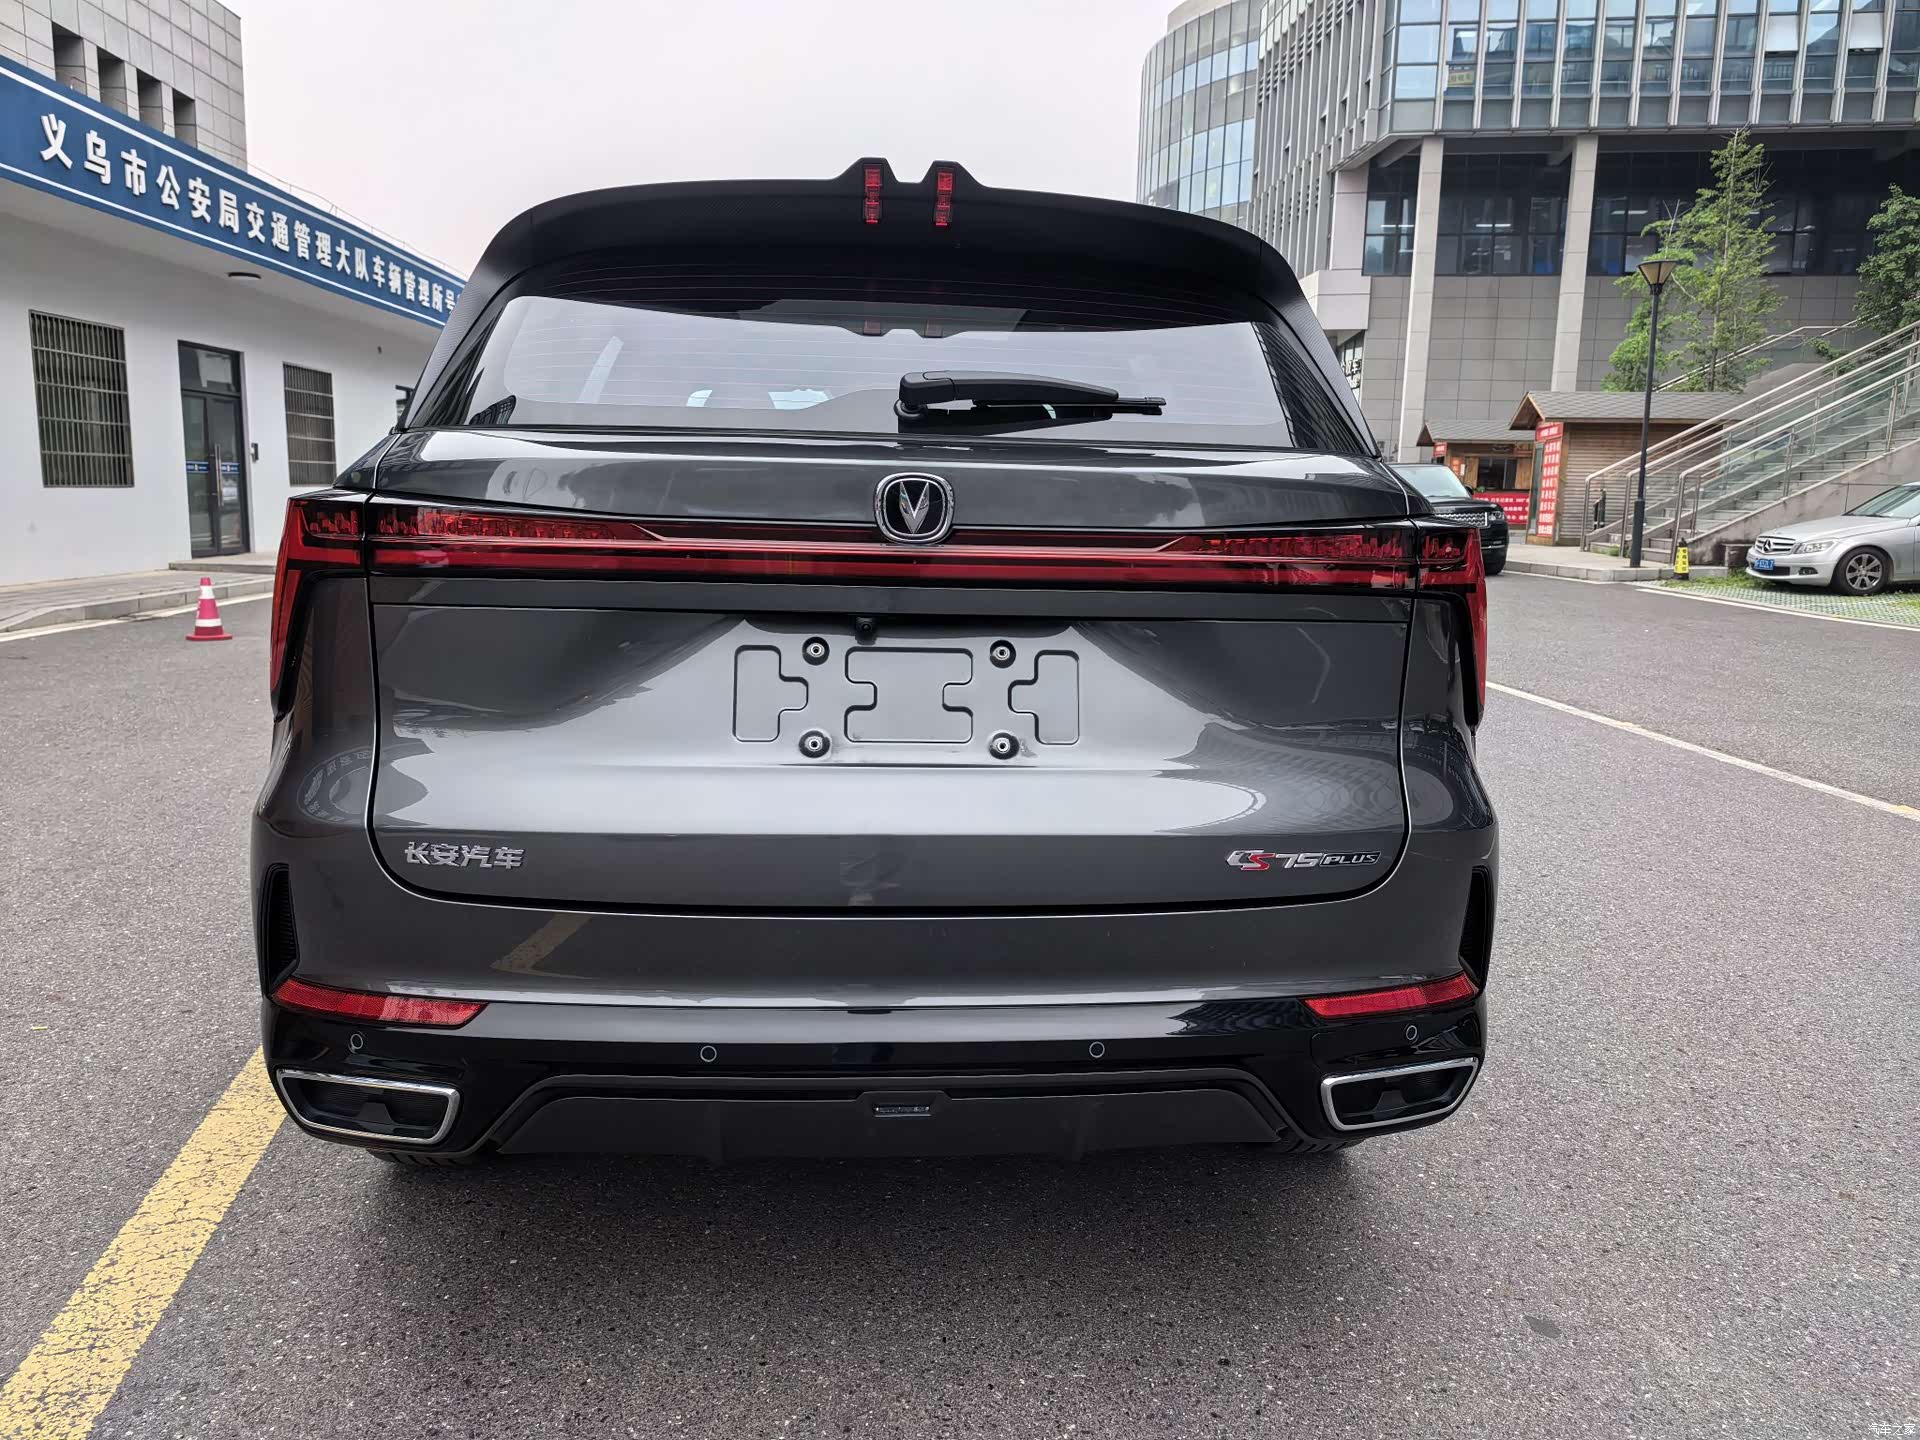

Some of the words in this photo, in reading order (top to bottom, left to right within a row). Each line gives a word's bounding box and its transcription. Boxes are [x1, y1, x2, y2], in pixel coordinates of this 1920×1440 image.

[40, 113, 460, 314] 义乌市公安局交通管理大队车辆管理所号
[404, 841, 526, 870] 长安汽车
[1323, 852, 1378, 865] PLUS
